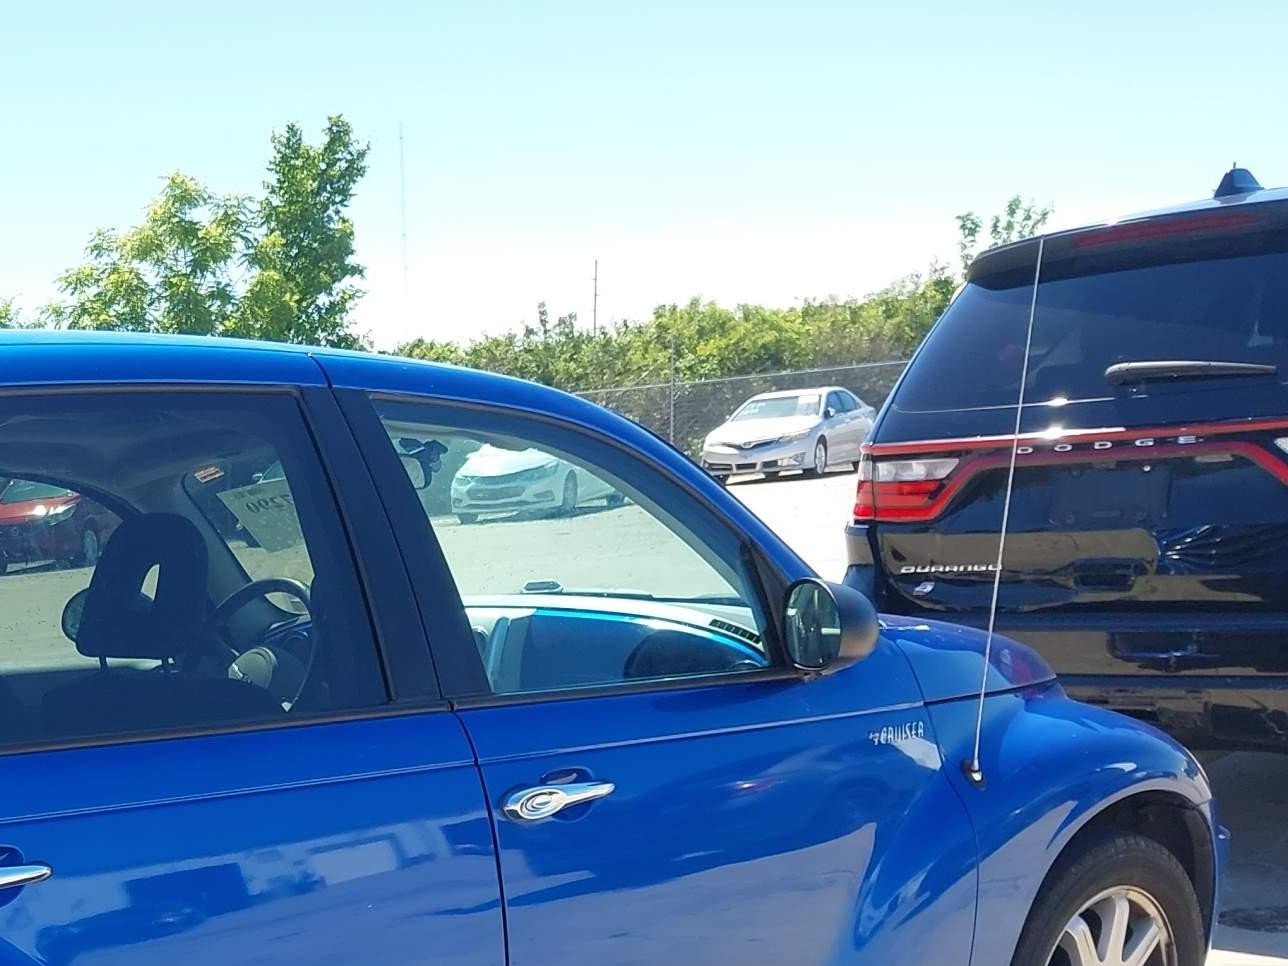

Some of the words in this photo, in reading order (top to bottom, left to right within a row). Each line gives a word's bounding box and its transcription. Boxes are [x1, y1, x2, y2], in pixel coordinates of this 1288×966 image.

[1016, 435, 1198, 455] DODGE
[900, 564, 1003, 573] DURANGO
[880, 721, 924, 744] CRUISER
